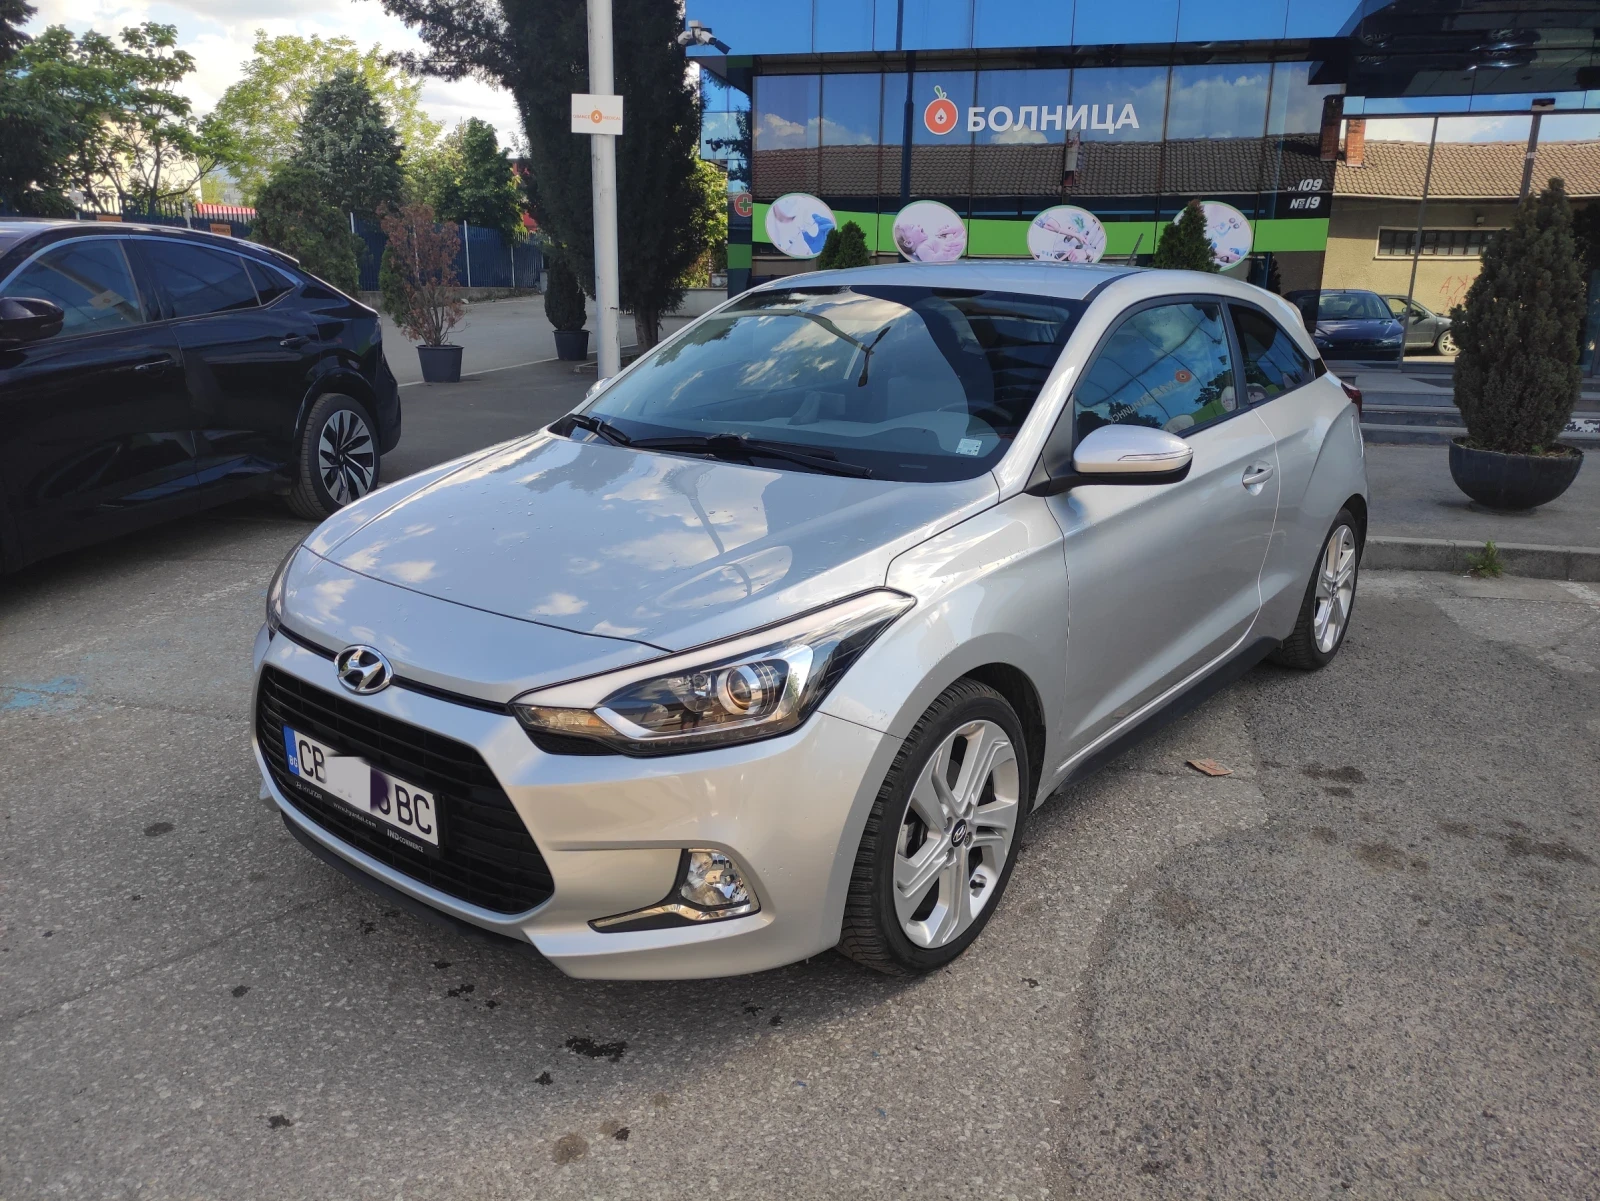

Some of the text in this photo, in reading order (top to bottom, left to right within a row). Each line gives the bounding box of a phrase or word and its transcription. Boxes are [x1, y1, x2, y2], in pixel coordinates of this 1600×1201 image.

[967, 104, 1140, 135] БОЛНИЦА
[1298, 178, 1323, 191] 109
[288, 754, 298, 768] BG
